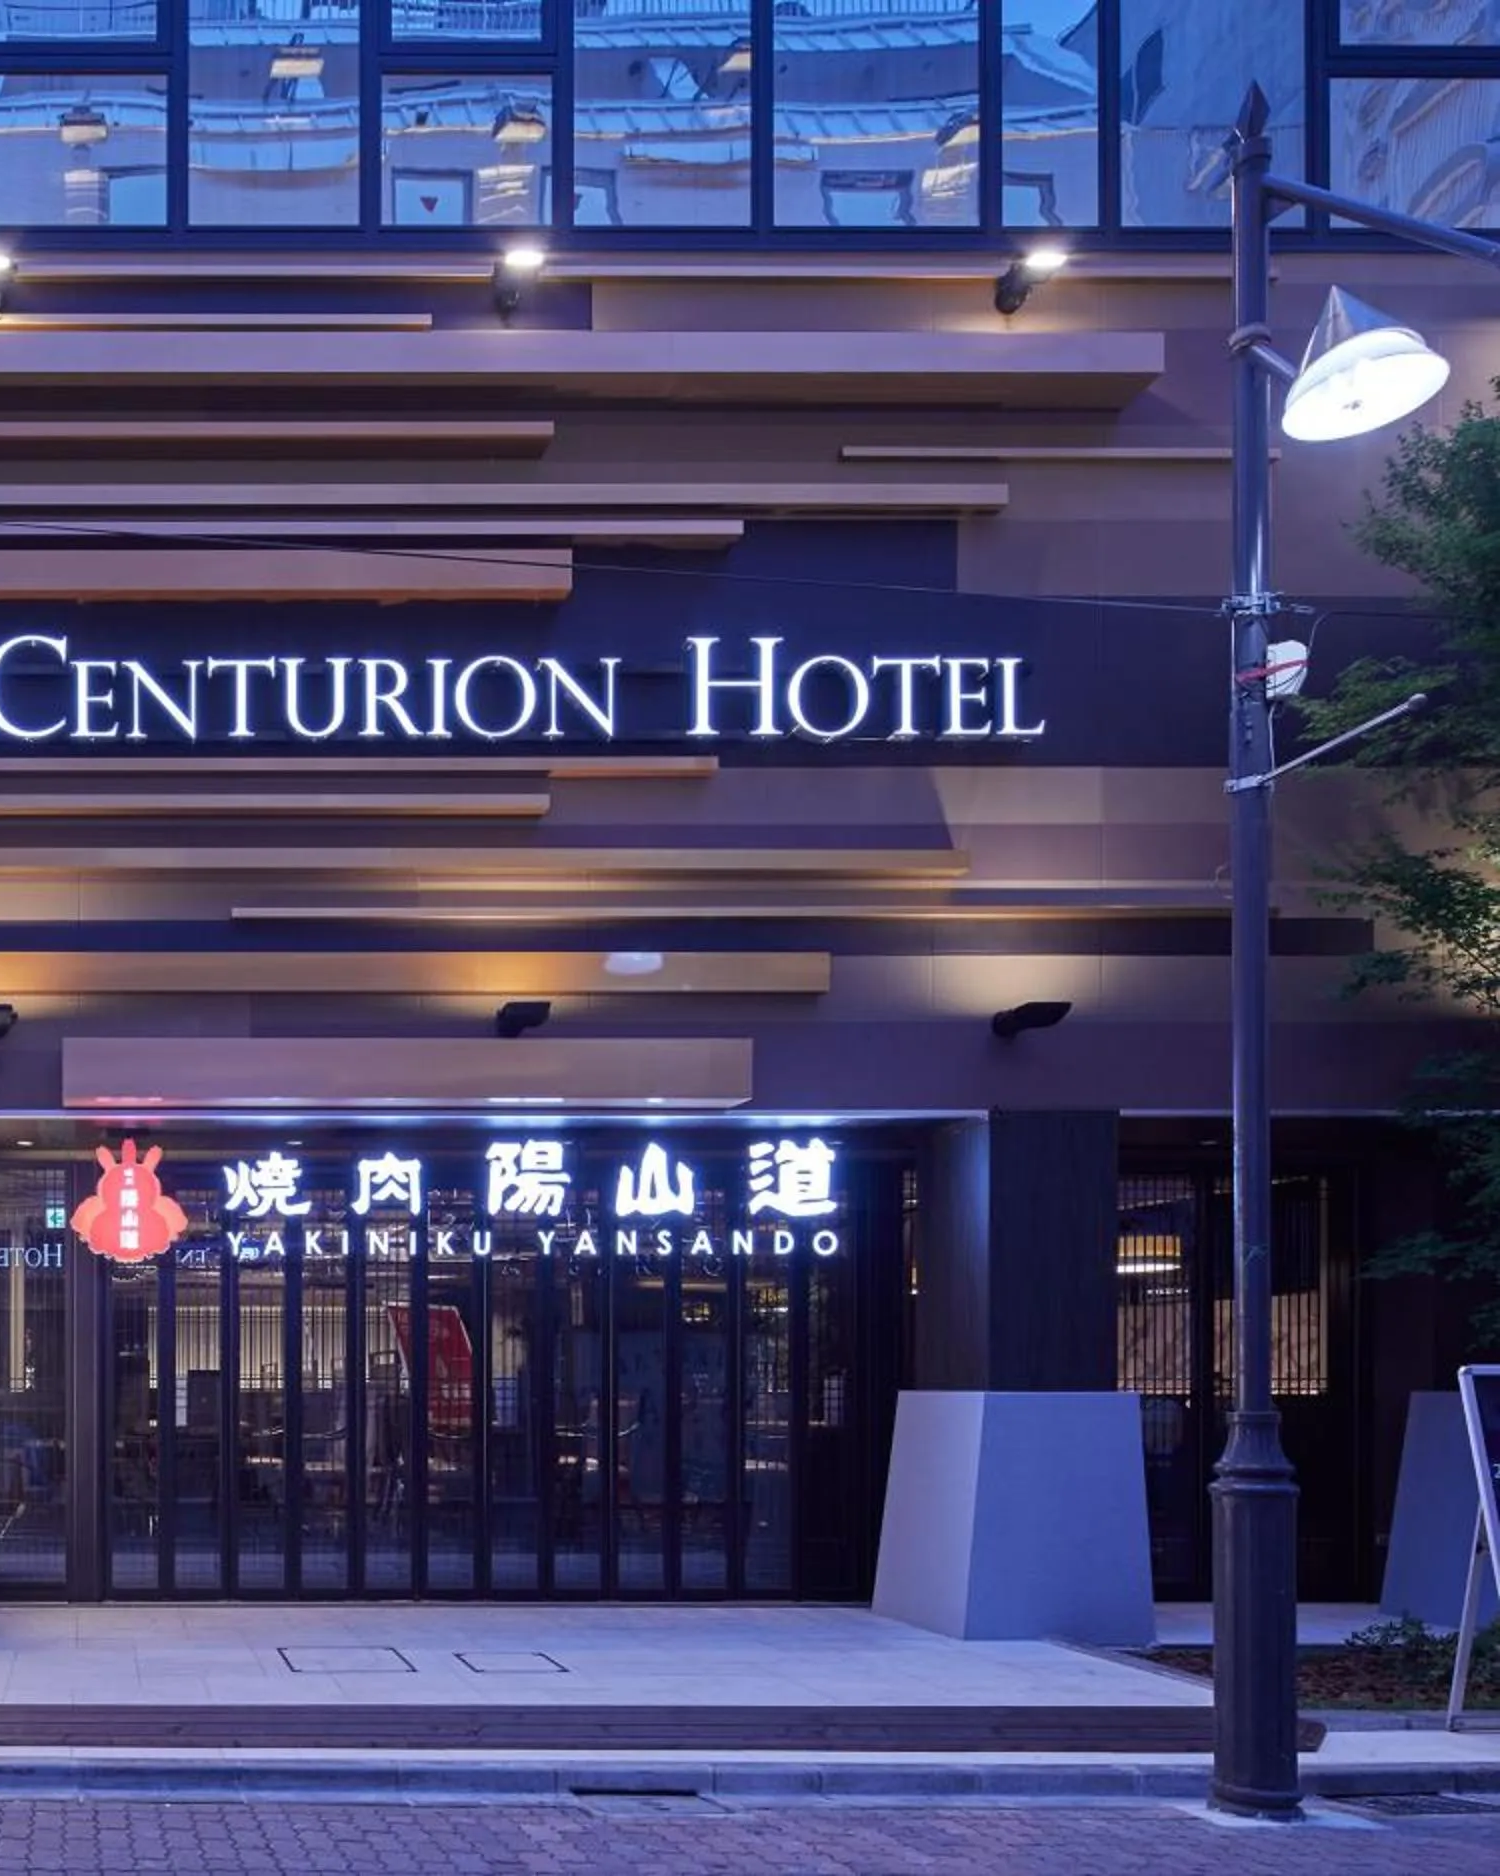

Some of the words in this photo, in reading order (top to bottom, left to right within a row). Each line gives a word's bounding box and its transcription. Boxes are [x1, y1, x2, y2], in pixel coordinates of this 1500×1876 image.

[687, 636, 1046, 741] HOTEL
[227, 1230, 492, 1256] YAKINIKU
[538, 1230, 839, 1256] YANSANDO
